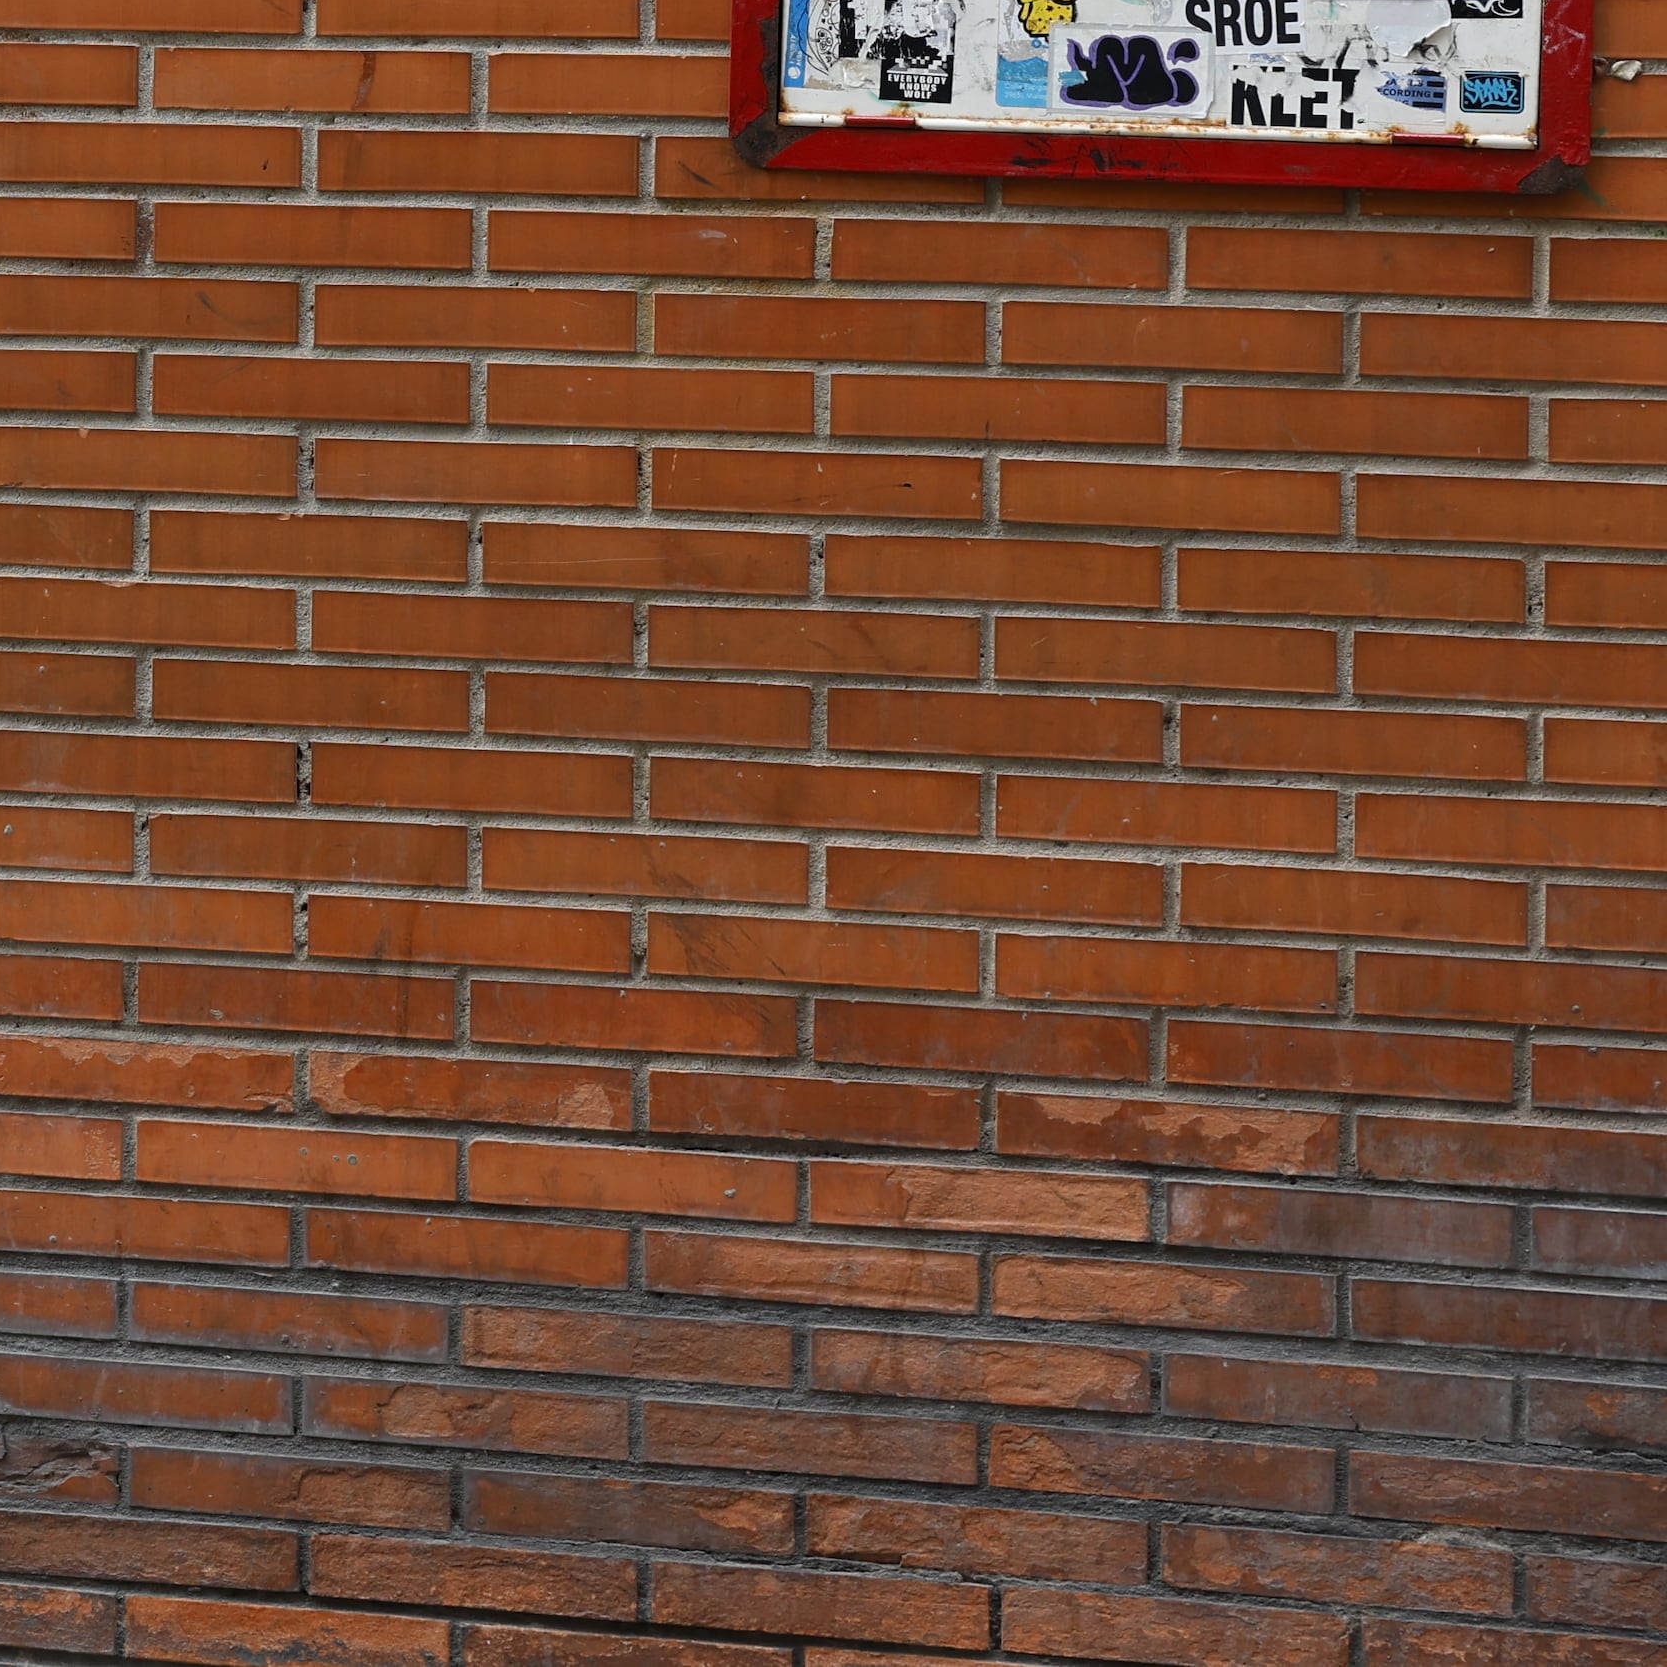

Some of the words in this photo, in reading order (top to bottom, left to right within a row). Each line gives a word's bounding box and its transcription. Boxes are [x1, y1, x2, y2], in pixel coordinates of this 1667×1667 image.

[887, 73, 947, 85] EVERYBODY
[899, 82, 937, 93] KNOWS
[903, 90, 932, 100] WOLF
